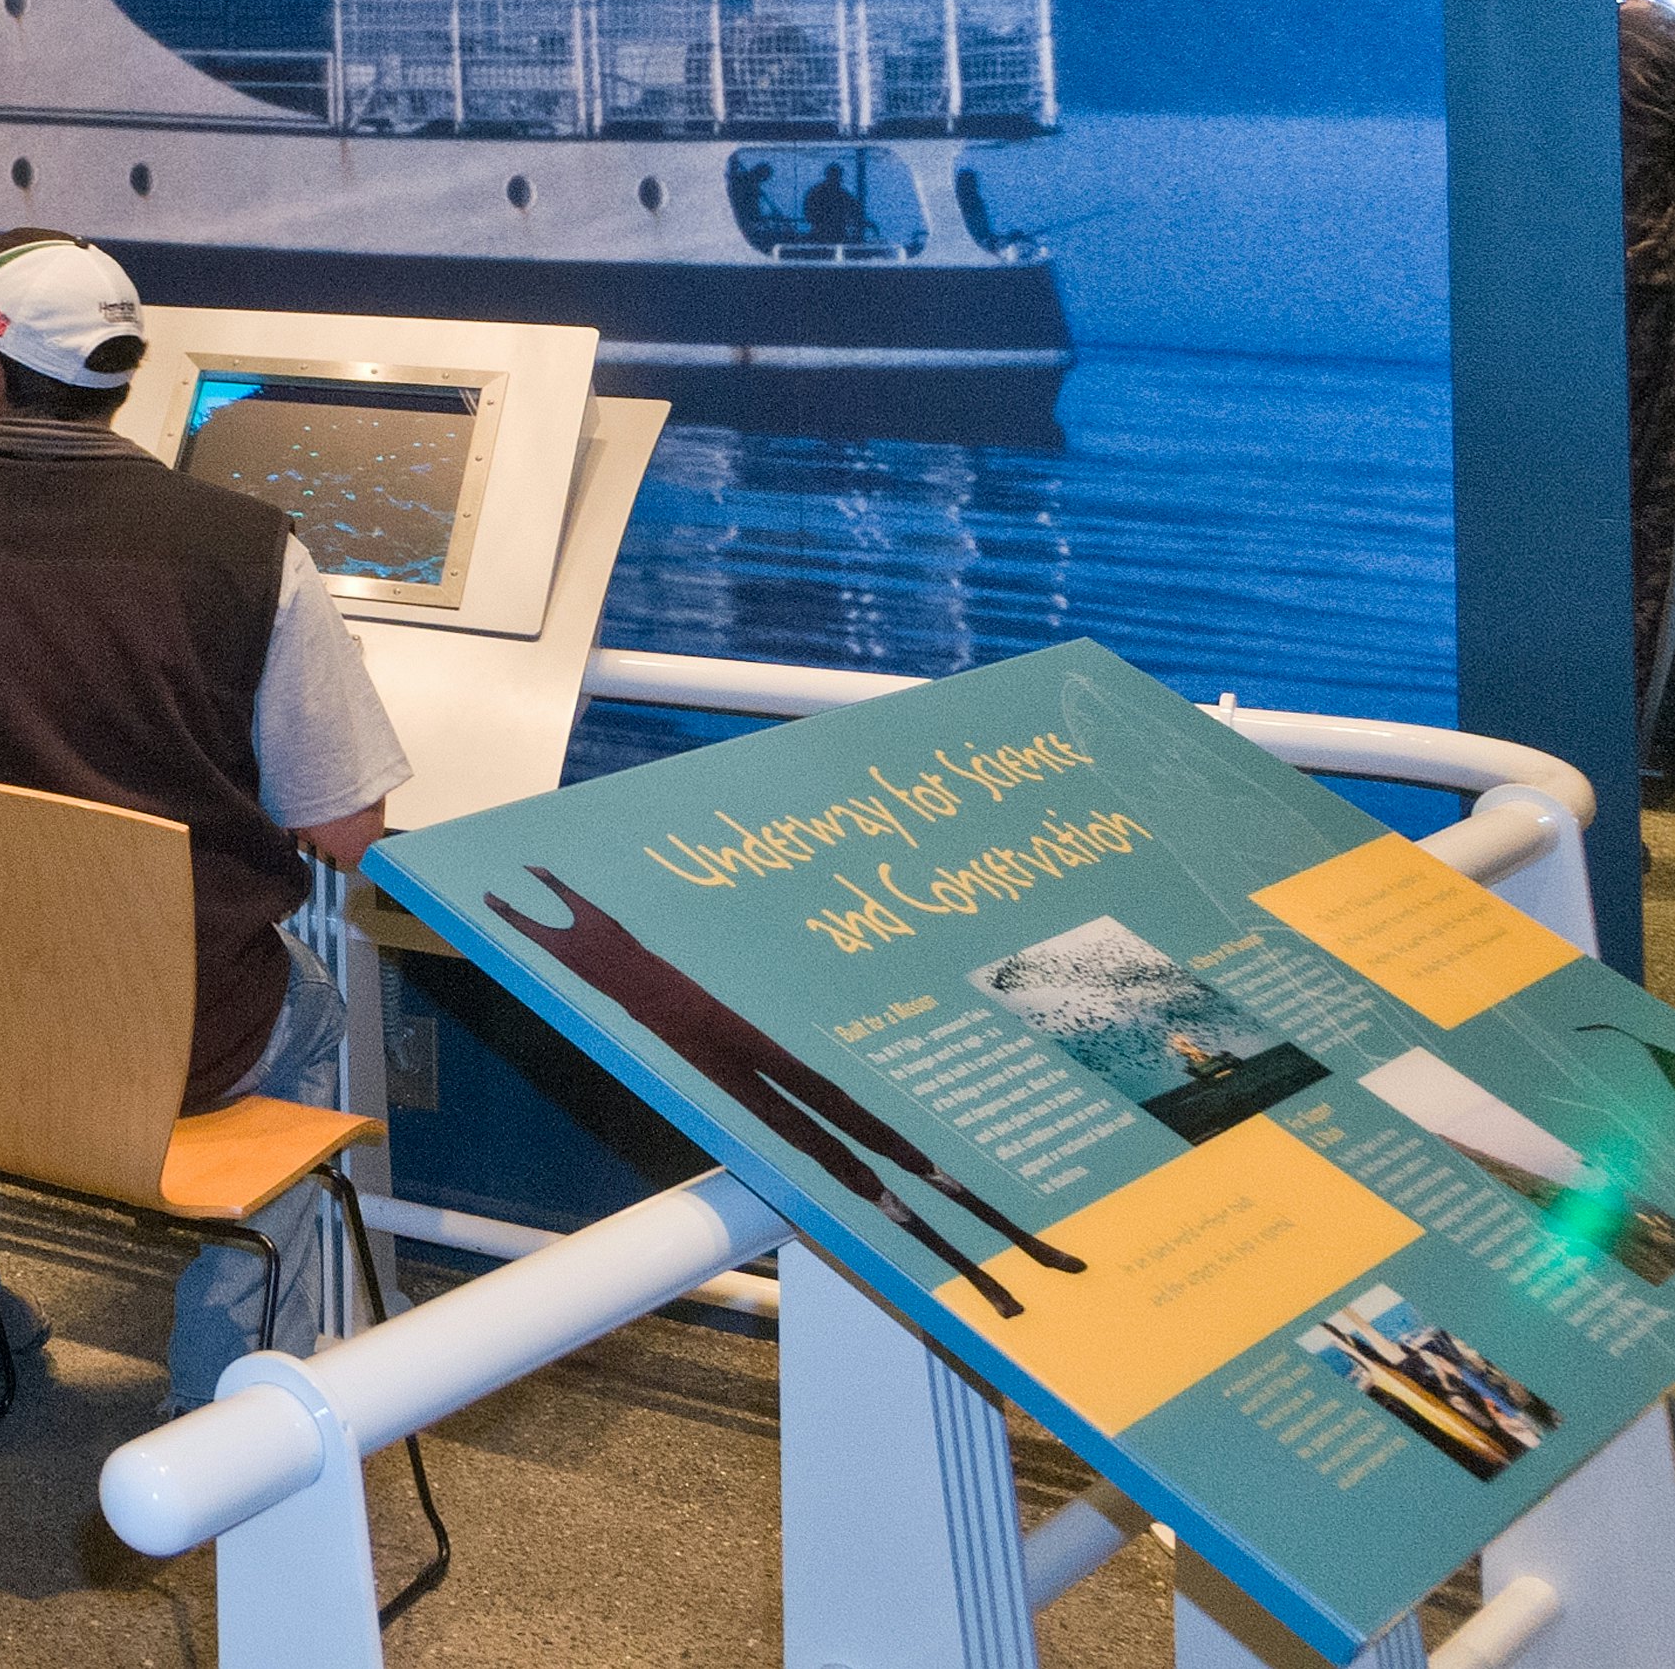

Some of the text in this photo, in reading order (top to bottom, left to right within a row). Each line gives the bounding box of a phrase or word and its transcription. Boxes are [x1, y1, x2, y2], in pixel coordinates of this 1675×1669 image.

[643, 732, 1094, 887] Underway for Science
[806, 809, 1153, 955] and Conservation
